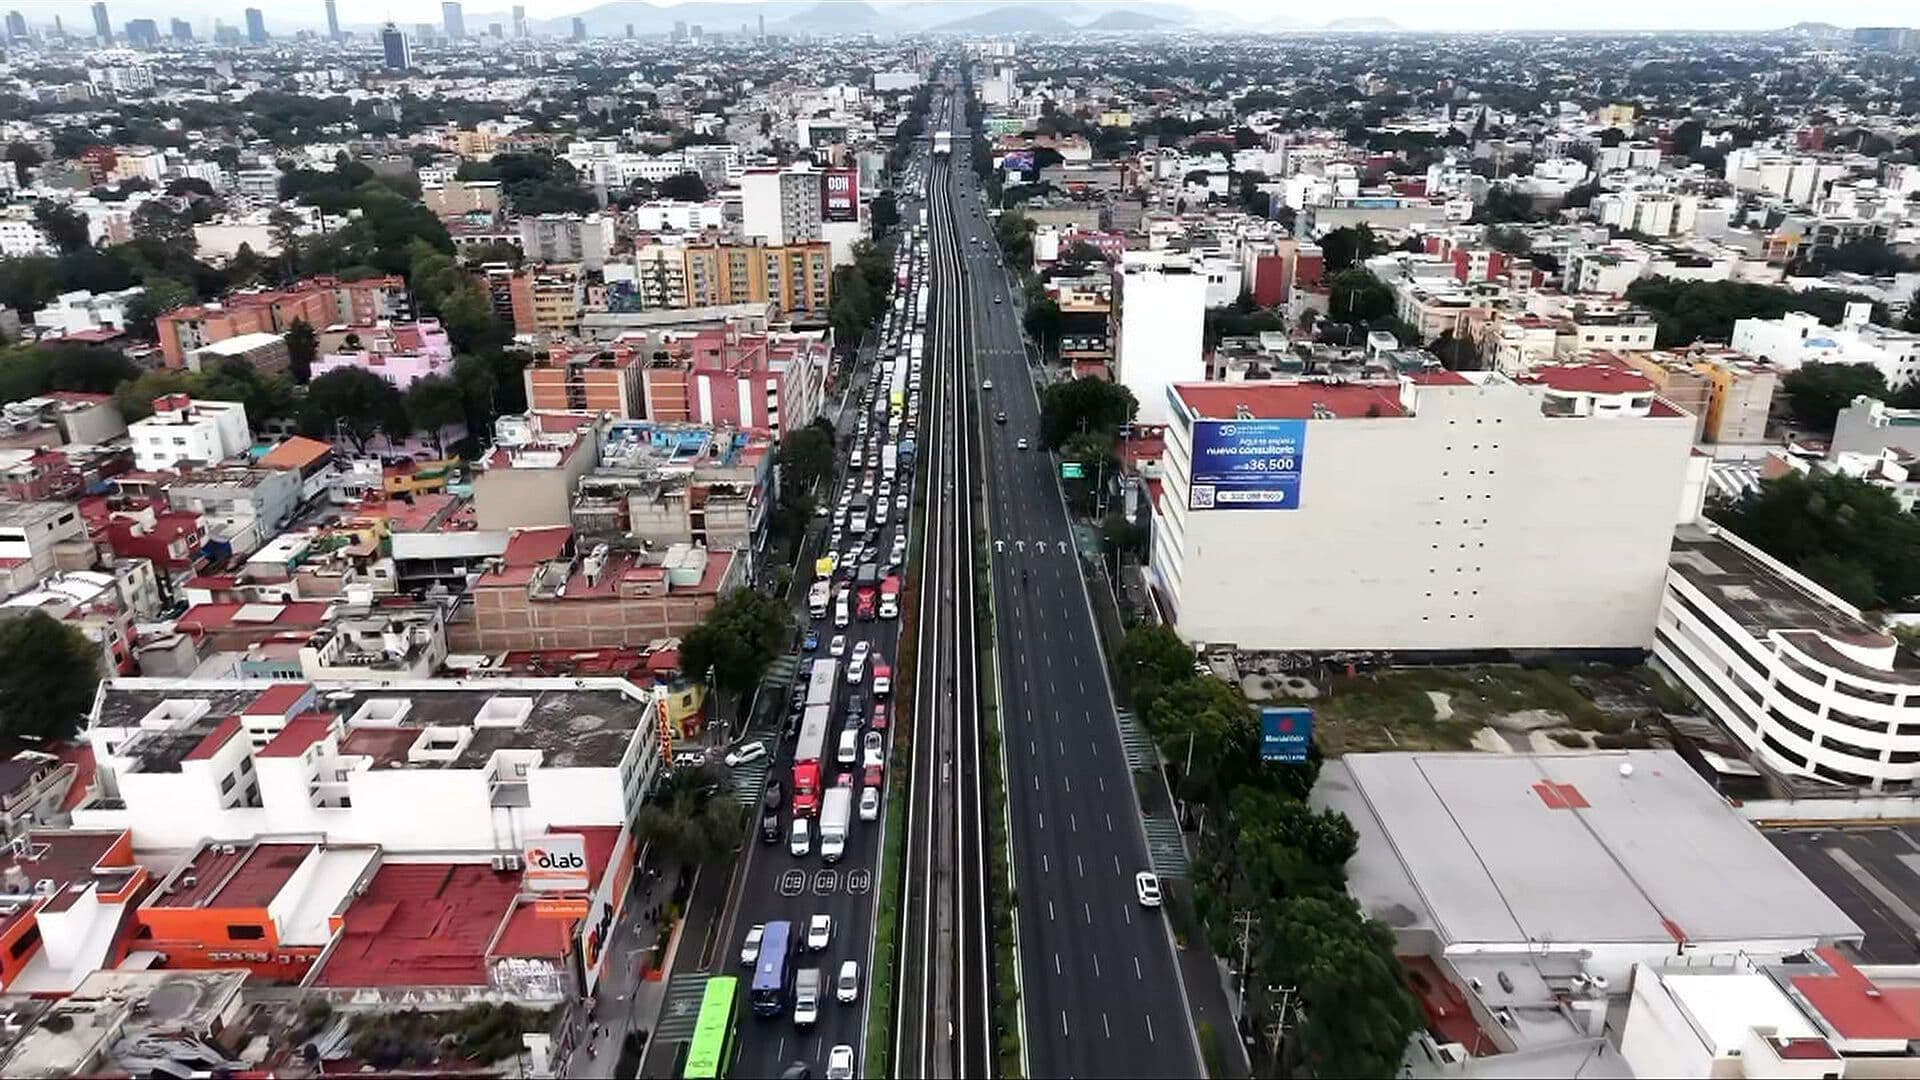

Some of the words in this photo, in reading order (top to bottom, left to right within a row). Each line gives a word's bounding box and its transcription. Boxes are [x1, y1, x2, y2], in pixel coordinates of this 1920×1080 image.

[1207, 447, 1237, 455] nuevo
[1239, 446, 1295, 455] consultorio
[538, 852, 584, 869] olab
